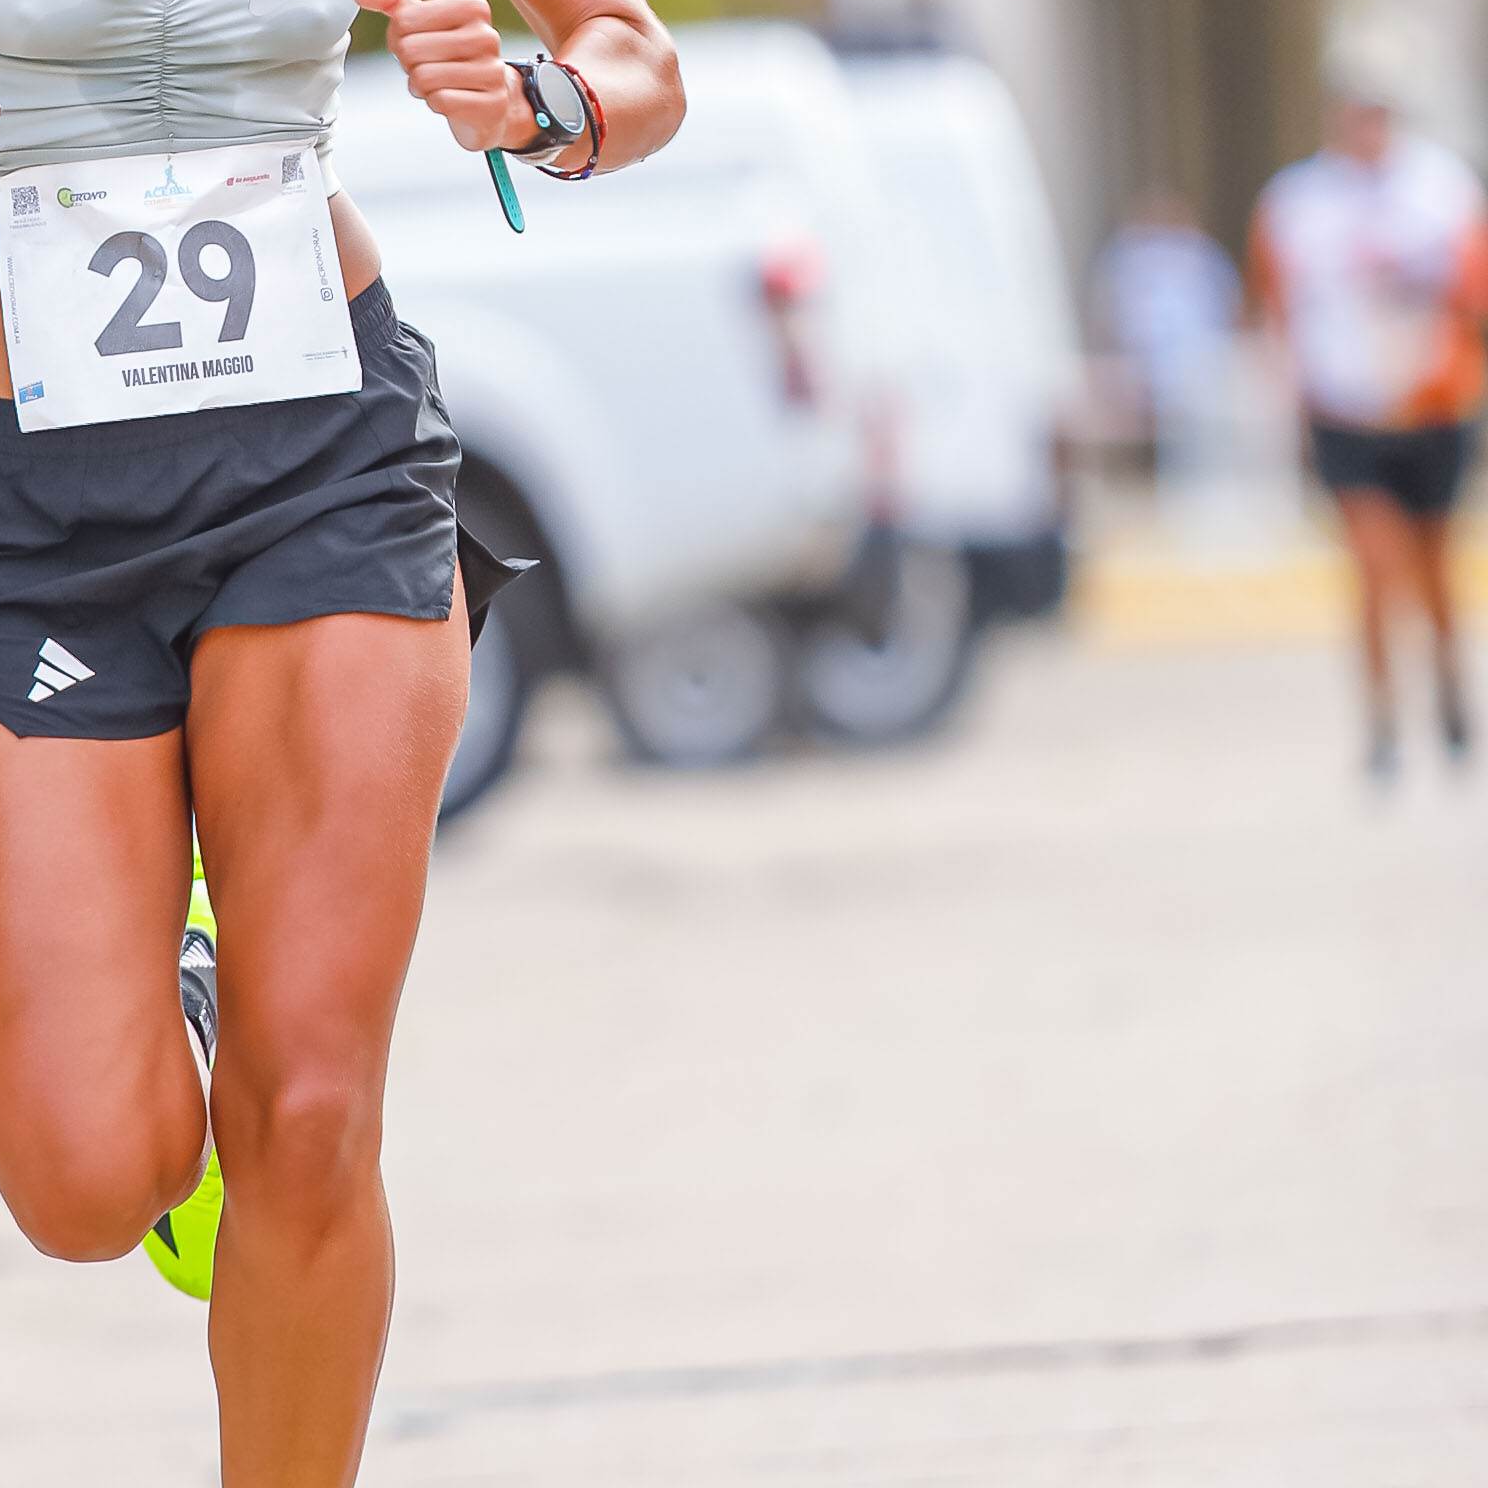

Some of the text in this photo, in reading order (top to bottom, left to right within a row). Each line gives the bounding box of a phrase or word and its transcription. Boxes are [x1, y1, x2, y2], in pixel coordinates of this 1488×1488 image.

[87, 220, 256, 357] 29
[122, 355, 254, 388] VALENTINA MAGGIO
